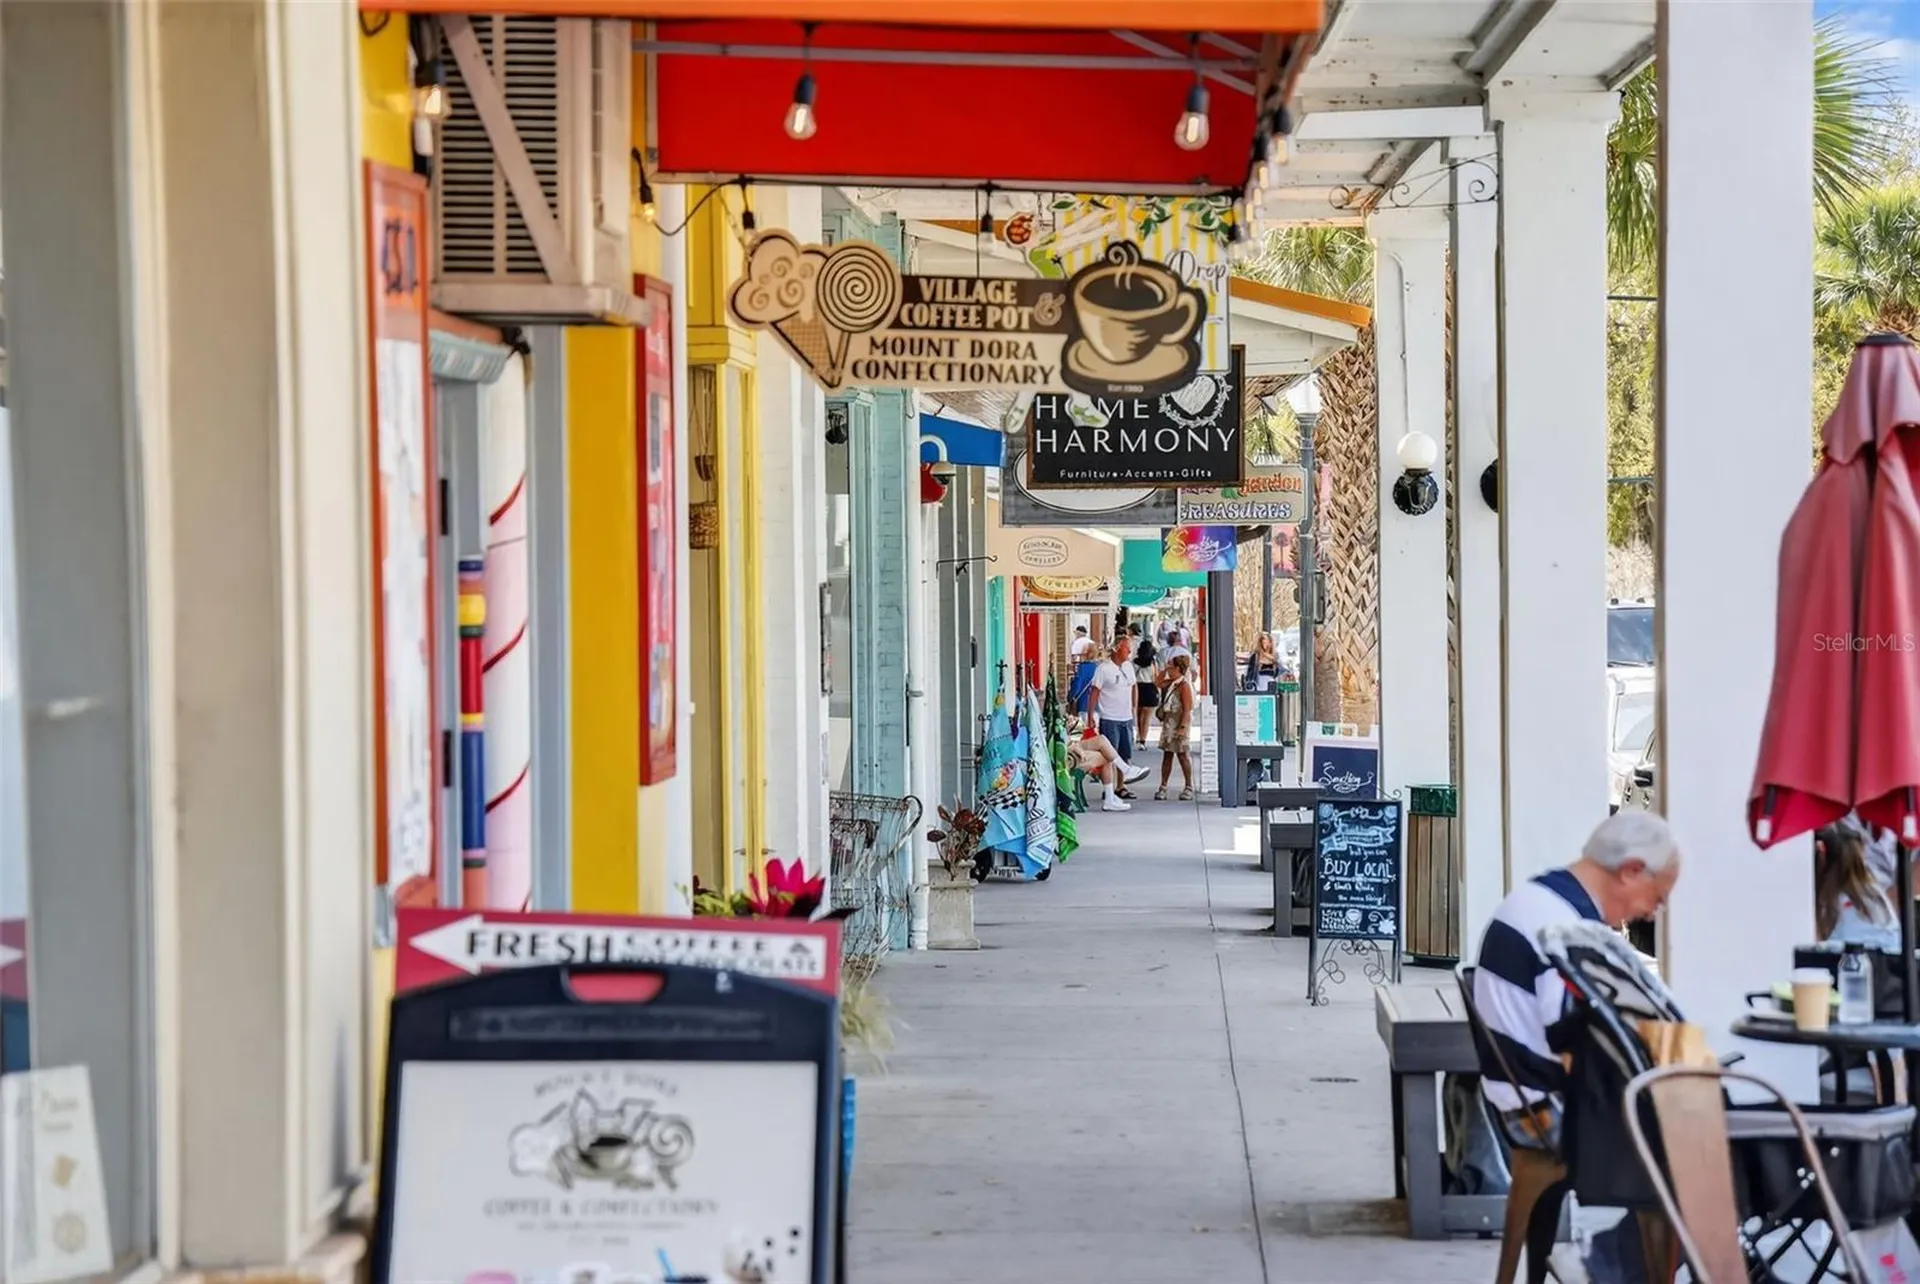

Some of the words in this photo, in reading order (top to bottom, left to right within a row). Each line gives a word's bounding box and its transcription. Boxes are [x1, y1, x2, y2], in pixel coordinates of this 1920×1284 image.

[918, 278, 1018, 304] VILLAGE
[901, 303, 982, 328] COFFEE
[986, 305, 1034, 330] POT
[1034, 292, 1066, 327] &
[869, 336, 960, 358] MOUNT
[969, 339, 1038, 361] DORA
[851, 359, 1055, 385] CONFECTIONARY
[1036, 428, 1236, 453] HARMONY
[1324, 857, 1351, 876] BUY
[1355, 861, 1391, 878] LOCAL
[468, 930, 612, 963] FRESH
